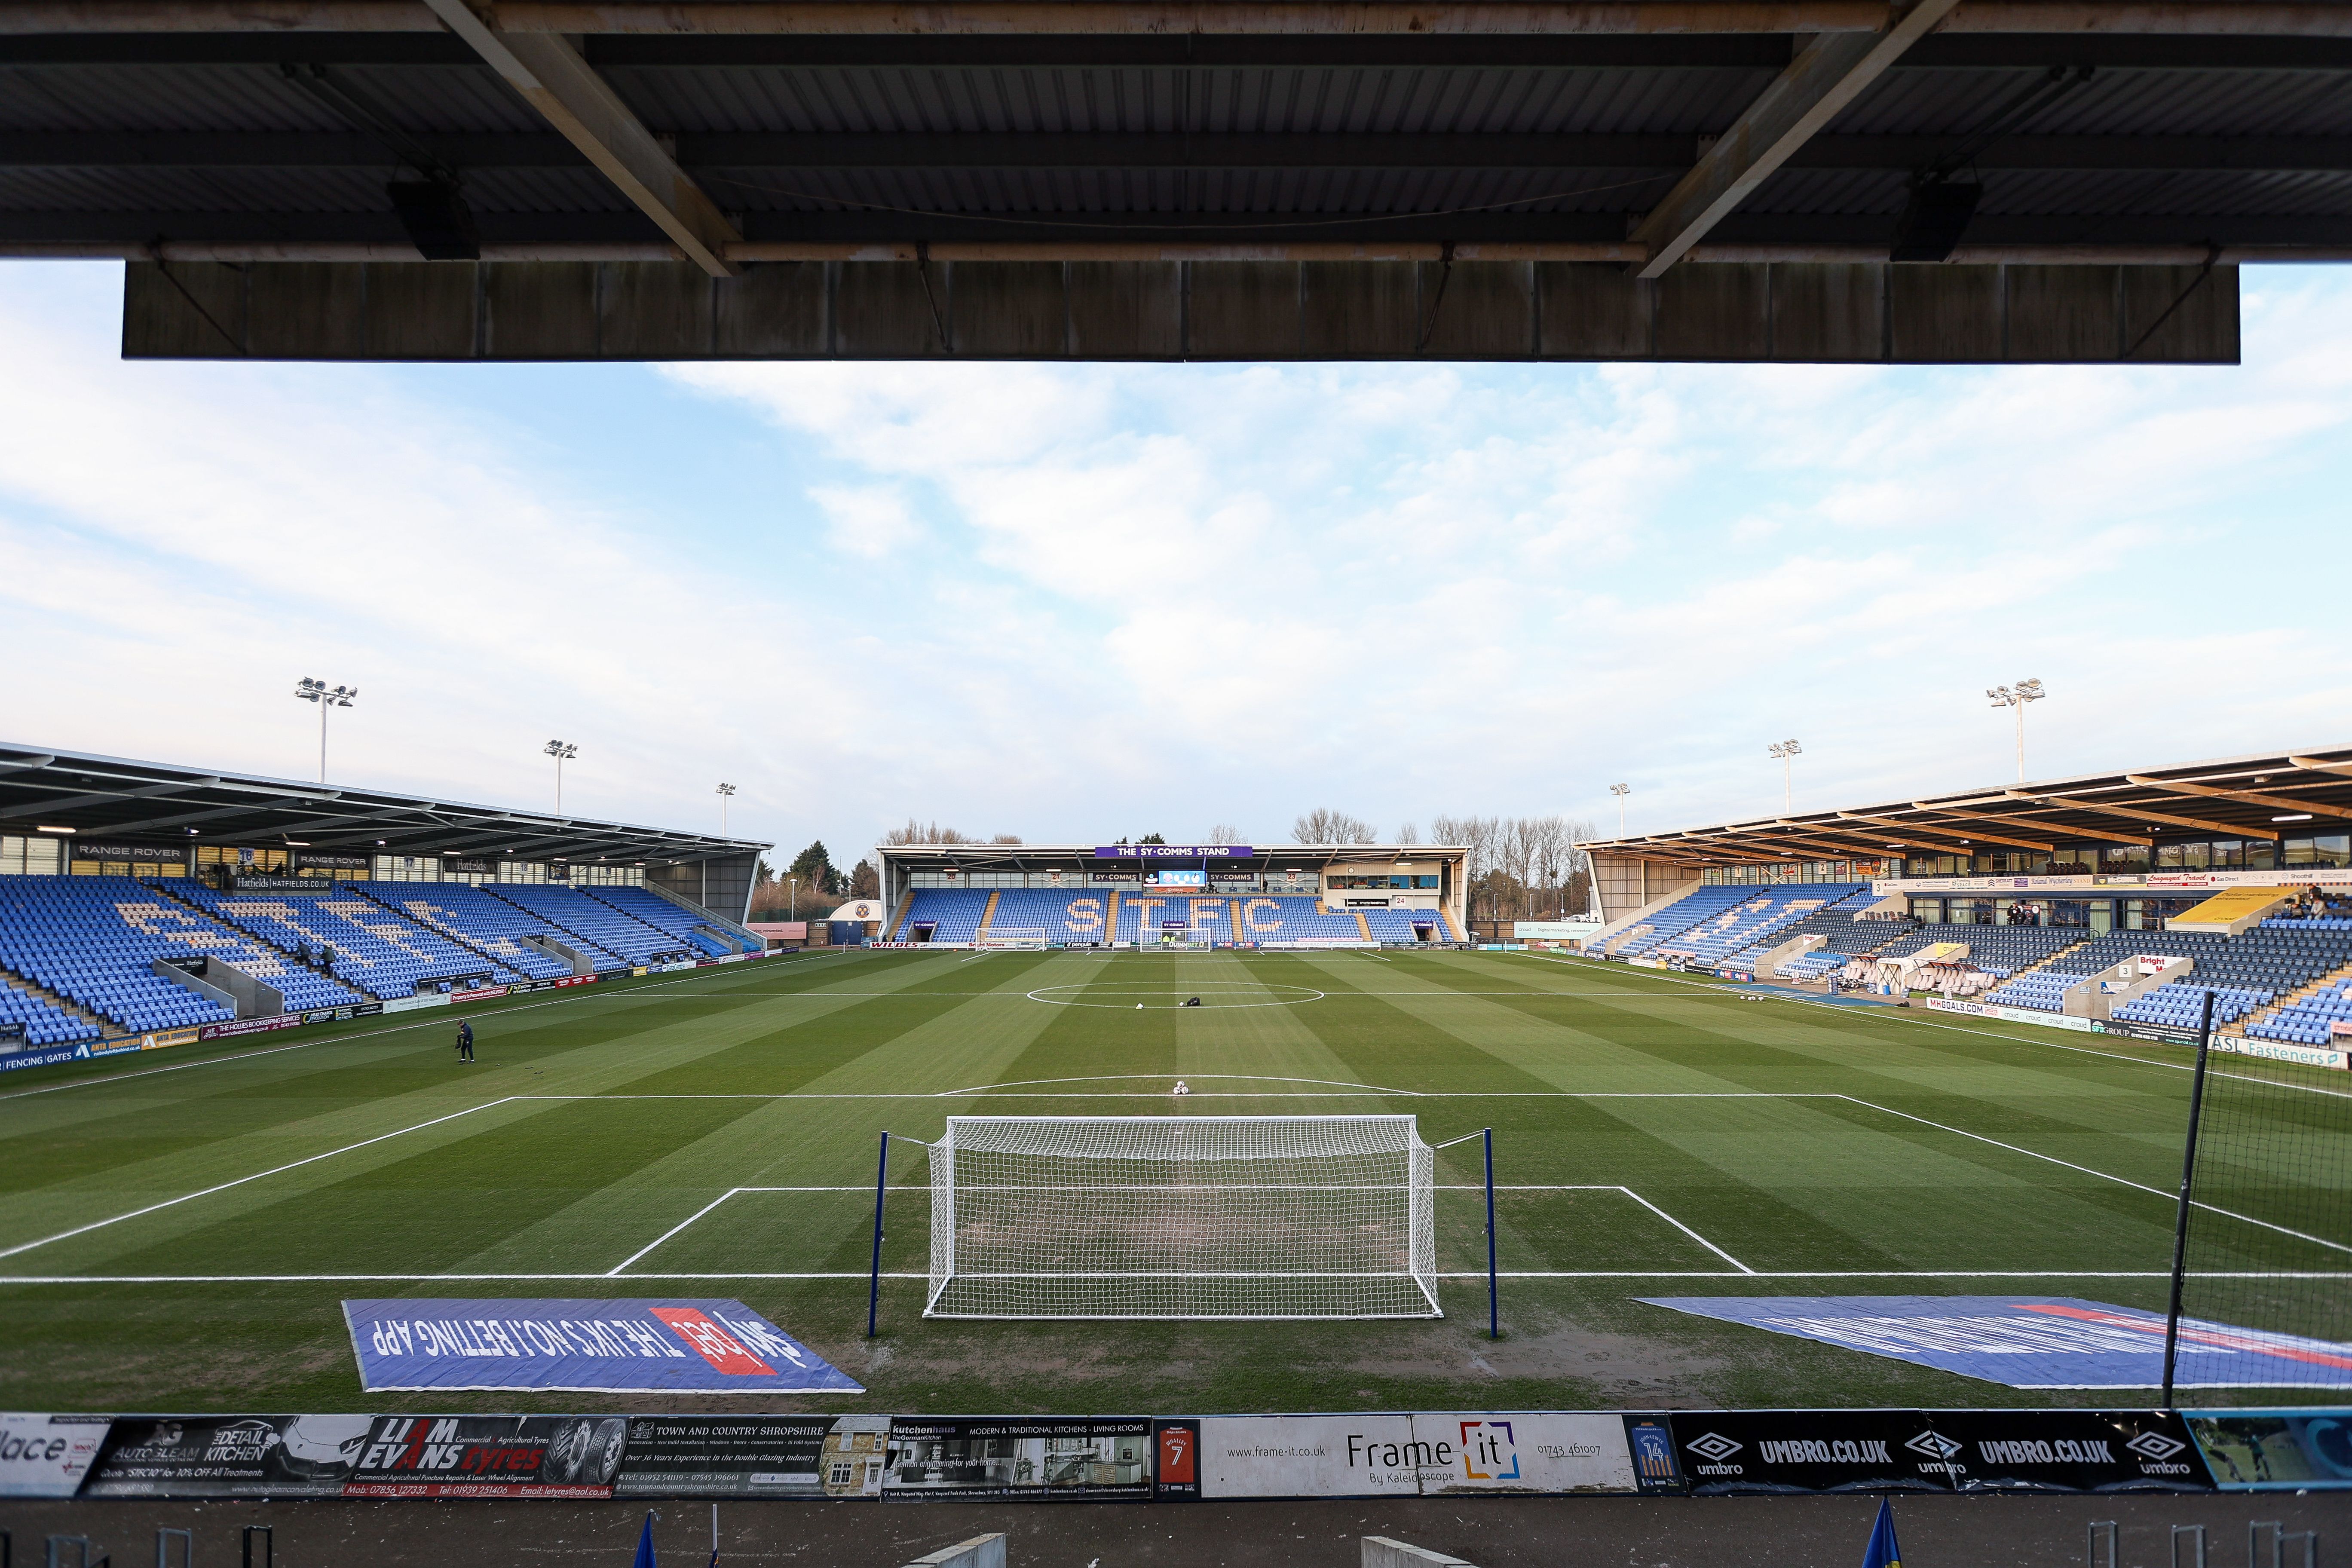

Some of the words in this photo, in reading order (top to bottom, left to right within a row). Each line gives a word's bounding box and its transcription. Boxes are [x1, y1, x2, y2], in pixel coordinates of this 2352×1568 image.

[80, 846, 130, 855] RANGE
[134, 848, 181, 857] ROVER
[240, 848, 252, 861] 16
[1117, 848, 1136, 856] THE
[1197, 847, 1229, 855] STAND
[405, 858, 413, 867] 17
[521, 863, 527, 872] 18
[237, 878, 269, 888] Hatfields
[2049, 876, 2073, 886] Wycherley
[2147, 874, 2181, 882] Longmynd
[1876, 883, 1880, 892] 3
[2140, 956, 2165, 965] Bright
[1930, 999, 1983, 1014] MHGOALS.COM
[229, 1022, 248, 1031] HOLLIES
[248, 1017, 281, 1028] BOOKKEEPING
[281, 1014, 300, 1023] SERVICES
[2104, 1027, 2130, 1037] GROUP
[91, 1043, 106, 1051] ANTA
[108, 1038, 141, 1049] EDUCATION
[93, 1045, 141, 1056] nobodyleftbehind.co.uk
[2211, 1035, 2242, 1054] ASL
[2249, 1042, 2324, 1065] Fasteners
[6, 1056, 43, 1069] FENCING
[47, 1052, 72, 1063] GATES
[373, 1320, 414, 1357] APP
[414, 1320, 520, 1357] BETTING
[611, 1320, 686, 1357] THE
[378, 1418, 459, 1443] LIAM
[656, 1427, 686, 1436] TOWN
[688, 1427, 709, 1435] AND
[712, 1427, 758, 1436] COUNTRY
[760, 1427, 824, 1436] SHROPSHIRE
[892, 1425, 956, 1434] kutchenhaus
[969, 1427, 1000, 1435] MODERN
[218, 1430, 263, 1445] DETAIL
[455, 1436, 491, 1444] Commercial
[497, 1436, 533, 1445] Agricultural
[1640, 1434, 1664, 1444] JOHN-LEWIS
[0, 1430, 67, 1461] lace
[1227, 1445, 1326, 1458] www.frame-it.co.uk
[1347, 1434, 1453, 1467] Frame
[1477, 1431, 1502, 1465] it
[1537, 1445, 1564, 1457] 01743
[1568, 1442, 1601, 1457] 461007
[1643, 1443, 1663, 1461] 14
[1758, 1439, 1893, 1464] UMBRO.CO.UK
[1978, 1439, 2117, 1464] UMBRO.CO.UK
[204, 1446, 267, 1461] KITCHEN
[359, 1444, 464, 1469] EVANS
[460, 1445, 544, 1474] tyres
[673, 1454, 711, 1463] Experience
[759, 1454, 785, 1463] Glazing
[786, 1454, 816, 1463] Industry
[1171, 1446, 1183, 1465] 7
[895, 1459, 918, 1468] German
[920, 1459, 953, 1469] engineering
[1697, 1460, 1744, 1475] umbro
[2139, 1461, 2191, 1476] umbro
[194, 1468, 210, 1477] OFF
[223, 1468, 263, 1477] Treatments
[1369, 1473, 1383, 1485] By
[1387, 1472, 1455, 1484] Kaleidoscope
[346, 1485, 368, 1494] Mob:
[369, 1485, 396, 1495] 07856
[398, 1485, 428, 1494] 127332
[438, 1485, 451, 1494] Tel:
[453, 1485, 478, 1494] 01939
[478, 1485, 508, 1495] 251406
[520, 1486, 543, 1496] Email:
[544, 1486, 609, 1497] letyres@aol.co.uk
[622, 1483, 738, 1491] www.townandcountryshropshire.co.uk
